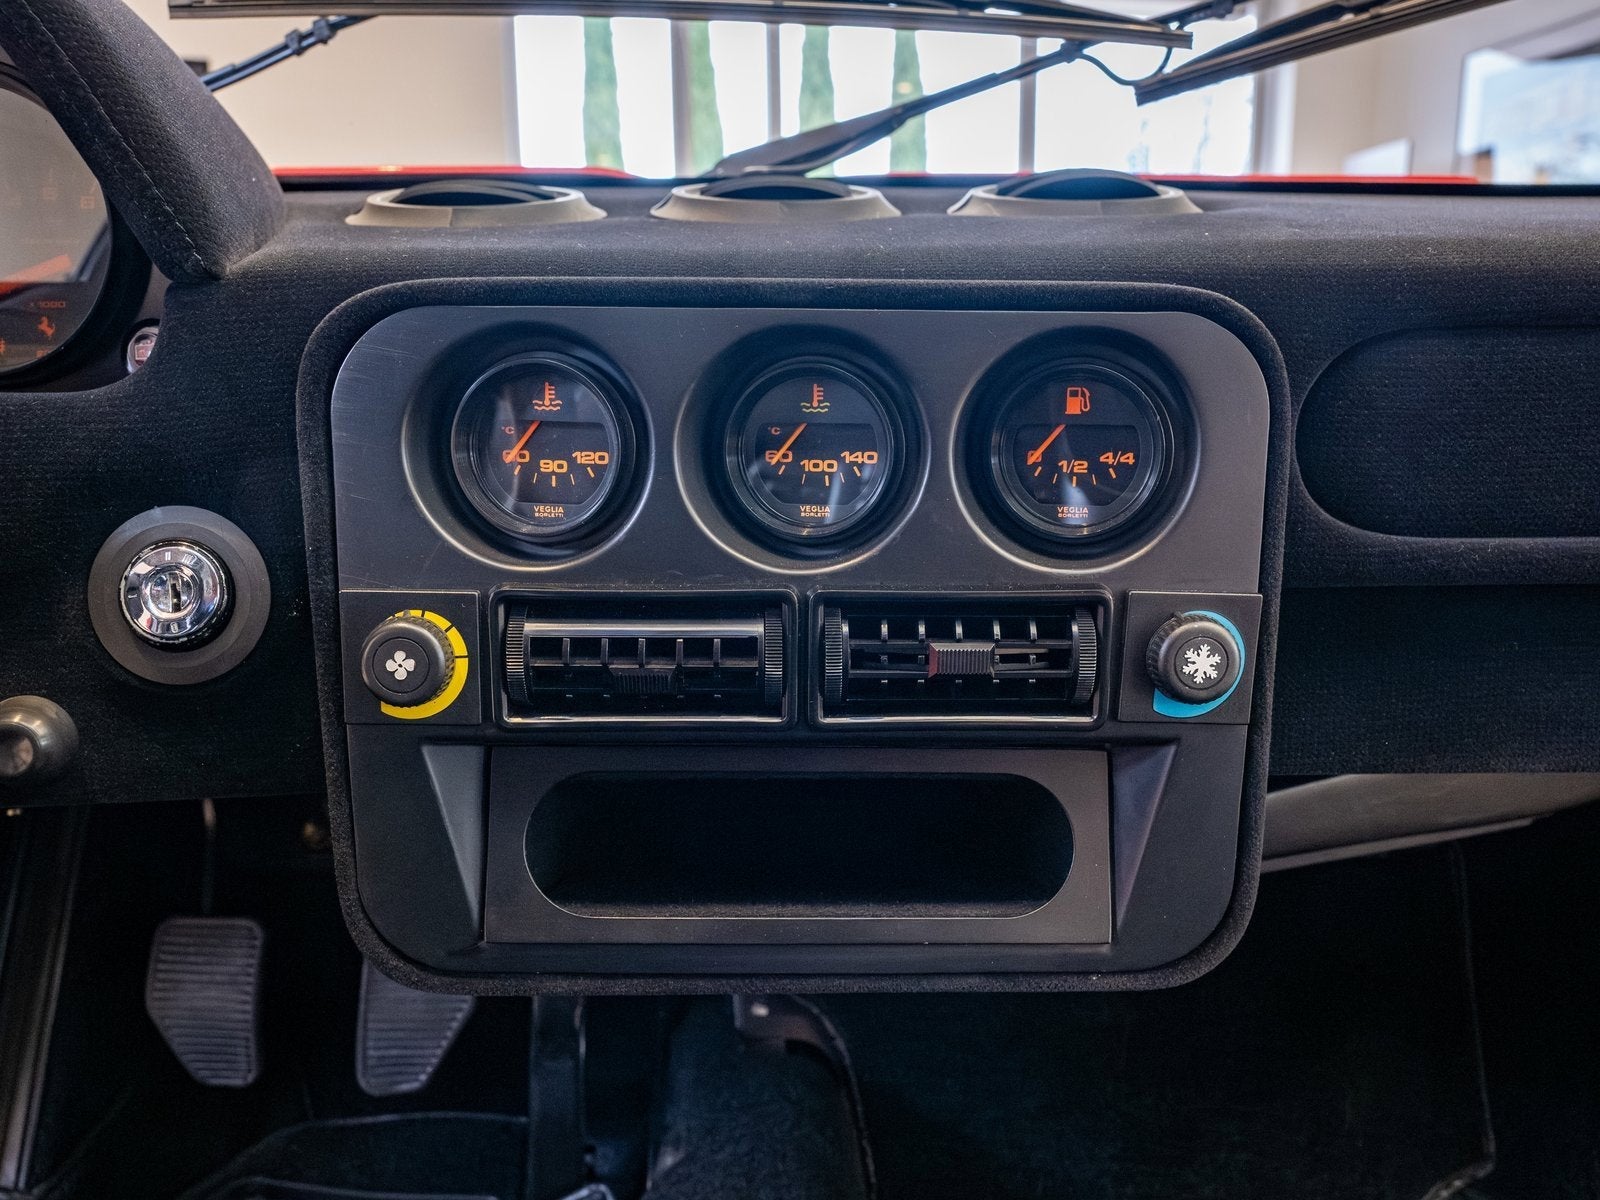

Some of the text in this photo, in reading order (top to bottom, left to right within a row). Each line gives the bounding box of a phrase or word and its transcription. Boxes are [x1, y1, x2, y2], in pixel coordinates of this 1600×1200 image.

[572, 451, 609, 465] 120
[765, 450, 793, 464] 60
[840, 451, 878, 464] 140
[1099, 451, 1135, 466] 4/4
[539, 459, 568, 473] 90
[800, 459, 838, 473] 100
[1058, 459, 1089, 474] 1/2
[533, 505, 564, 513] VEGLIA
[799, 505, 831, 513] VEGLIA
[1057, 506, 1089, 514] VEGLIA
